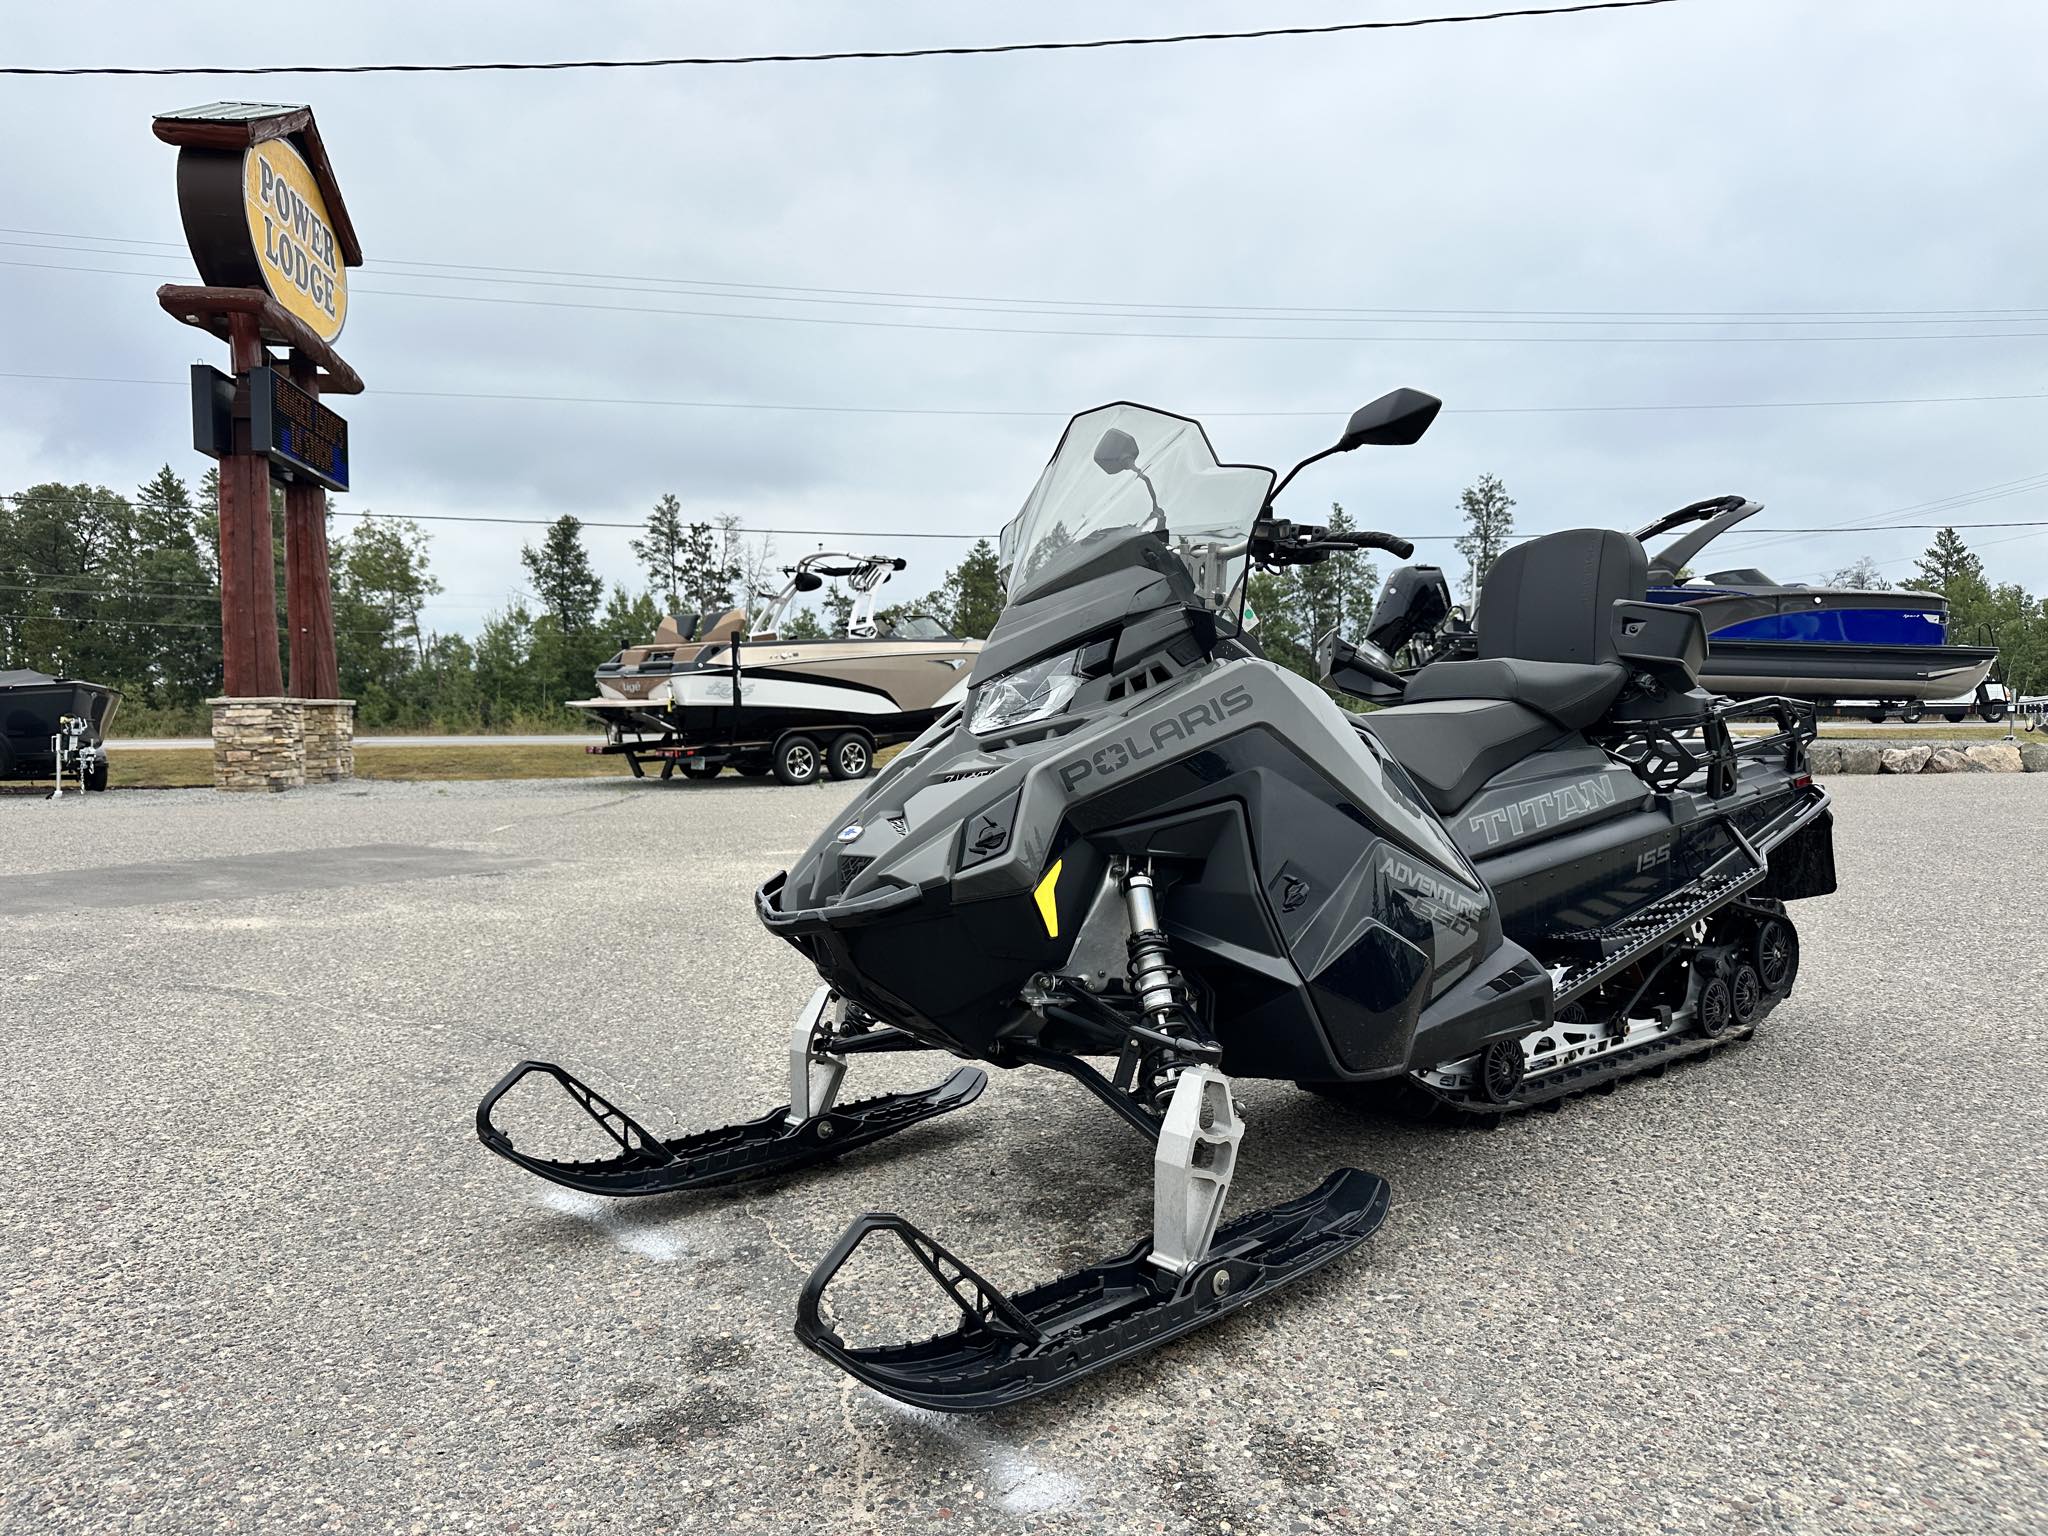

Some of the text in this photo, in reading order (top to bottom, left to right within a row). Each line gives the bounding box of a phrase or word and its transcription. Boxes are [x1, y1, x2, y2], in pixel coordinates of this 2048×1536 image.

[258, 156, 337, 275] POWER
[264, 215, 336, 319] LODGE
[1058, 684, 1254, 793] POLARIS
[1468, 774, 1616, 846] TITAN
[1379, 857, 1482, 922] ADVENTURE
[1636, 842, 1671, 874] 155
